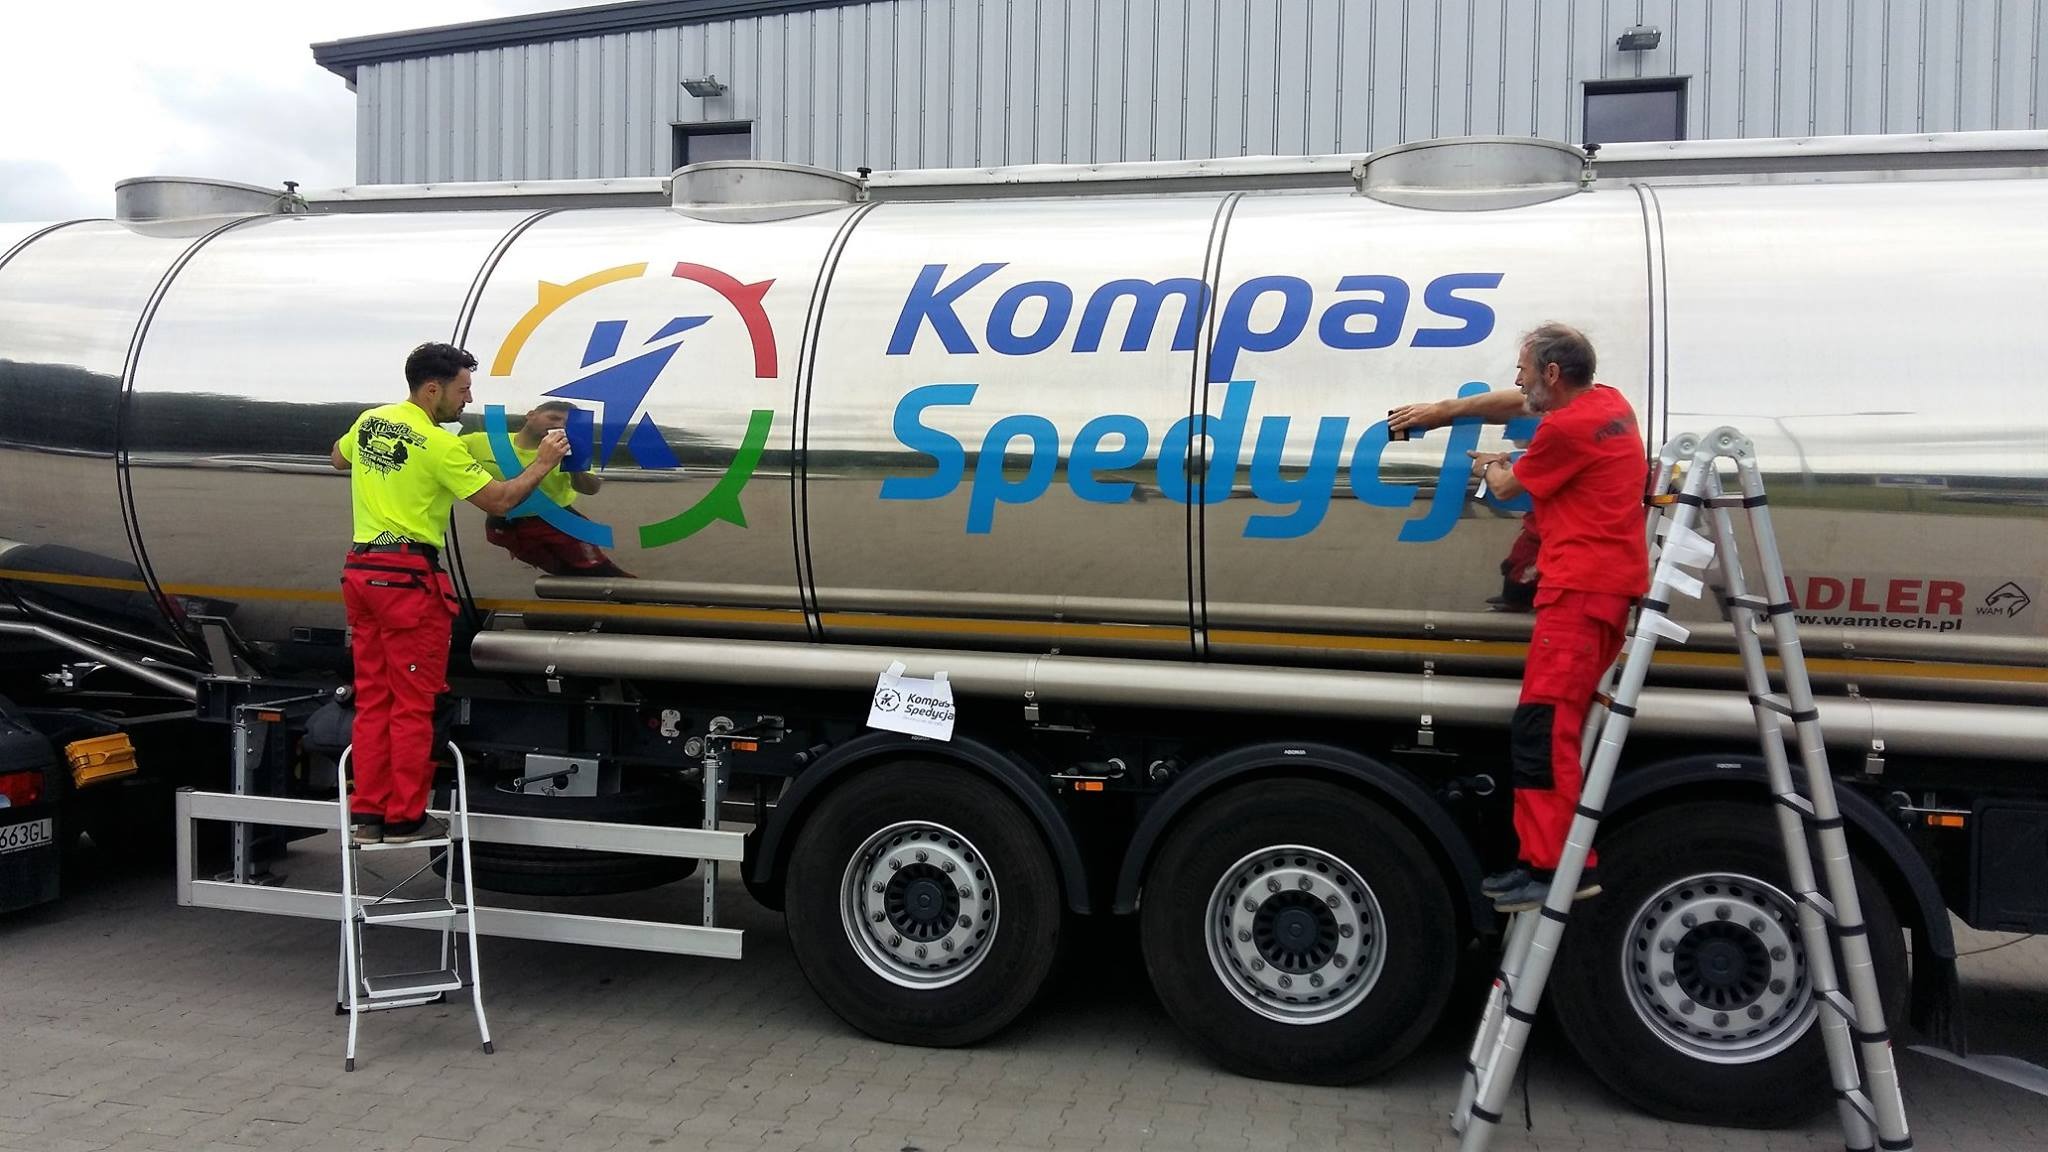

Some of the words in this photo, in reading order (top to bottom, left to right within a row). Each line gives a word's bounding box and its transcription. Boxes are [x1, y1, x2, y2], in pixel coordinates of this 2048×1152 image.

[886, 262, 1505, 383] Kompas
[1976, 607, 2004, 616] WAM
[1759, 614, 1962, 632] ww.wamtech.pl
[907, 693, 951, 708] Kompas
[904, 704, 955, 721] Spedycja
[0, 821, 50, 849] 663GL
